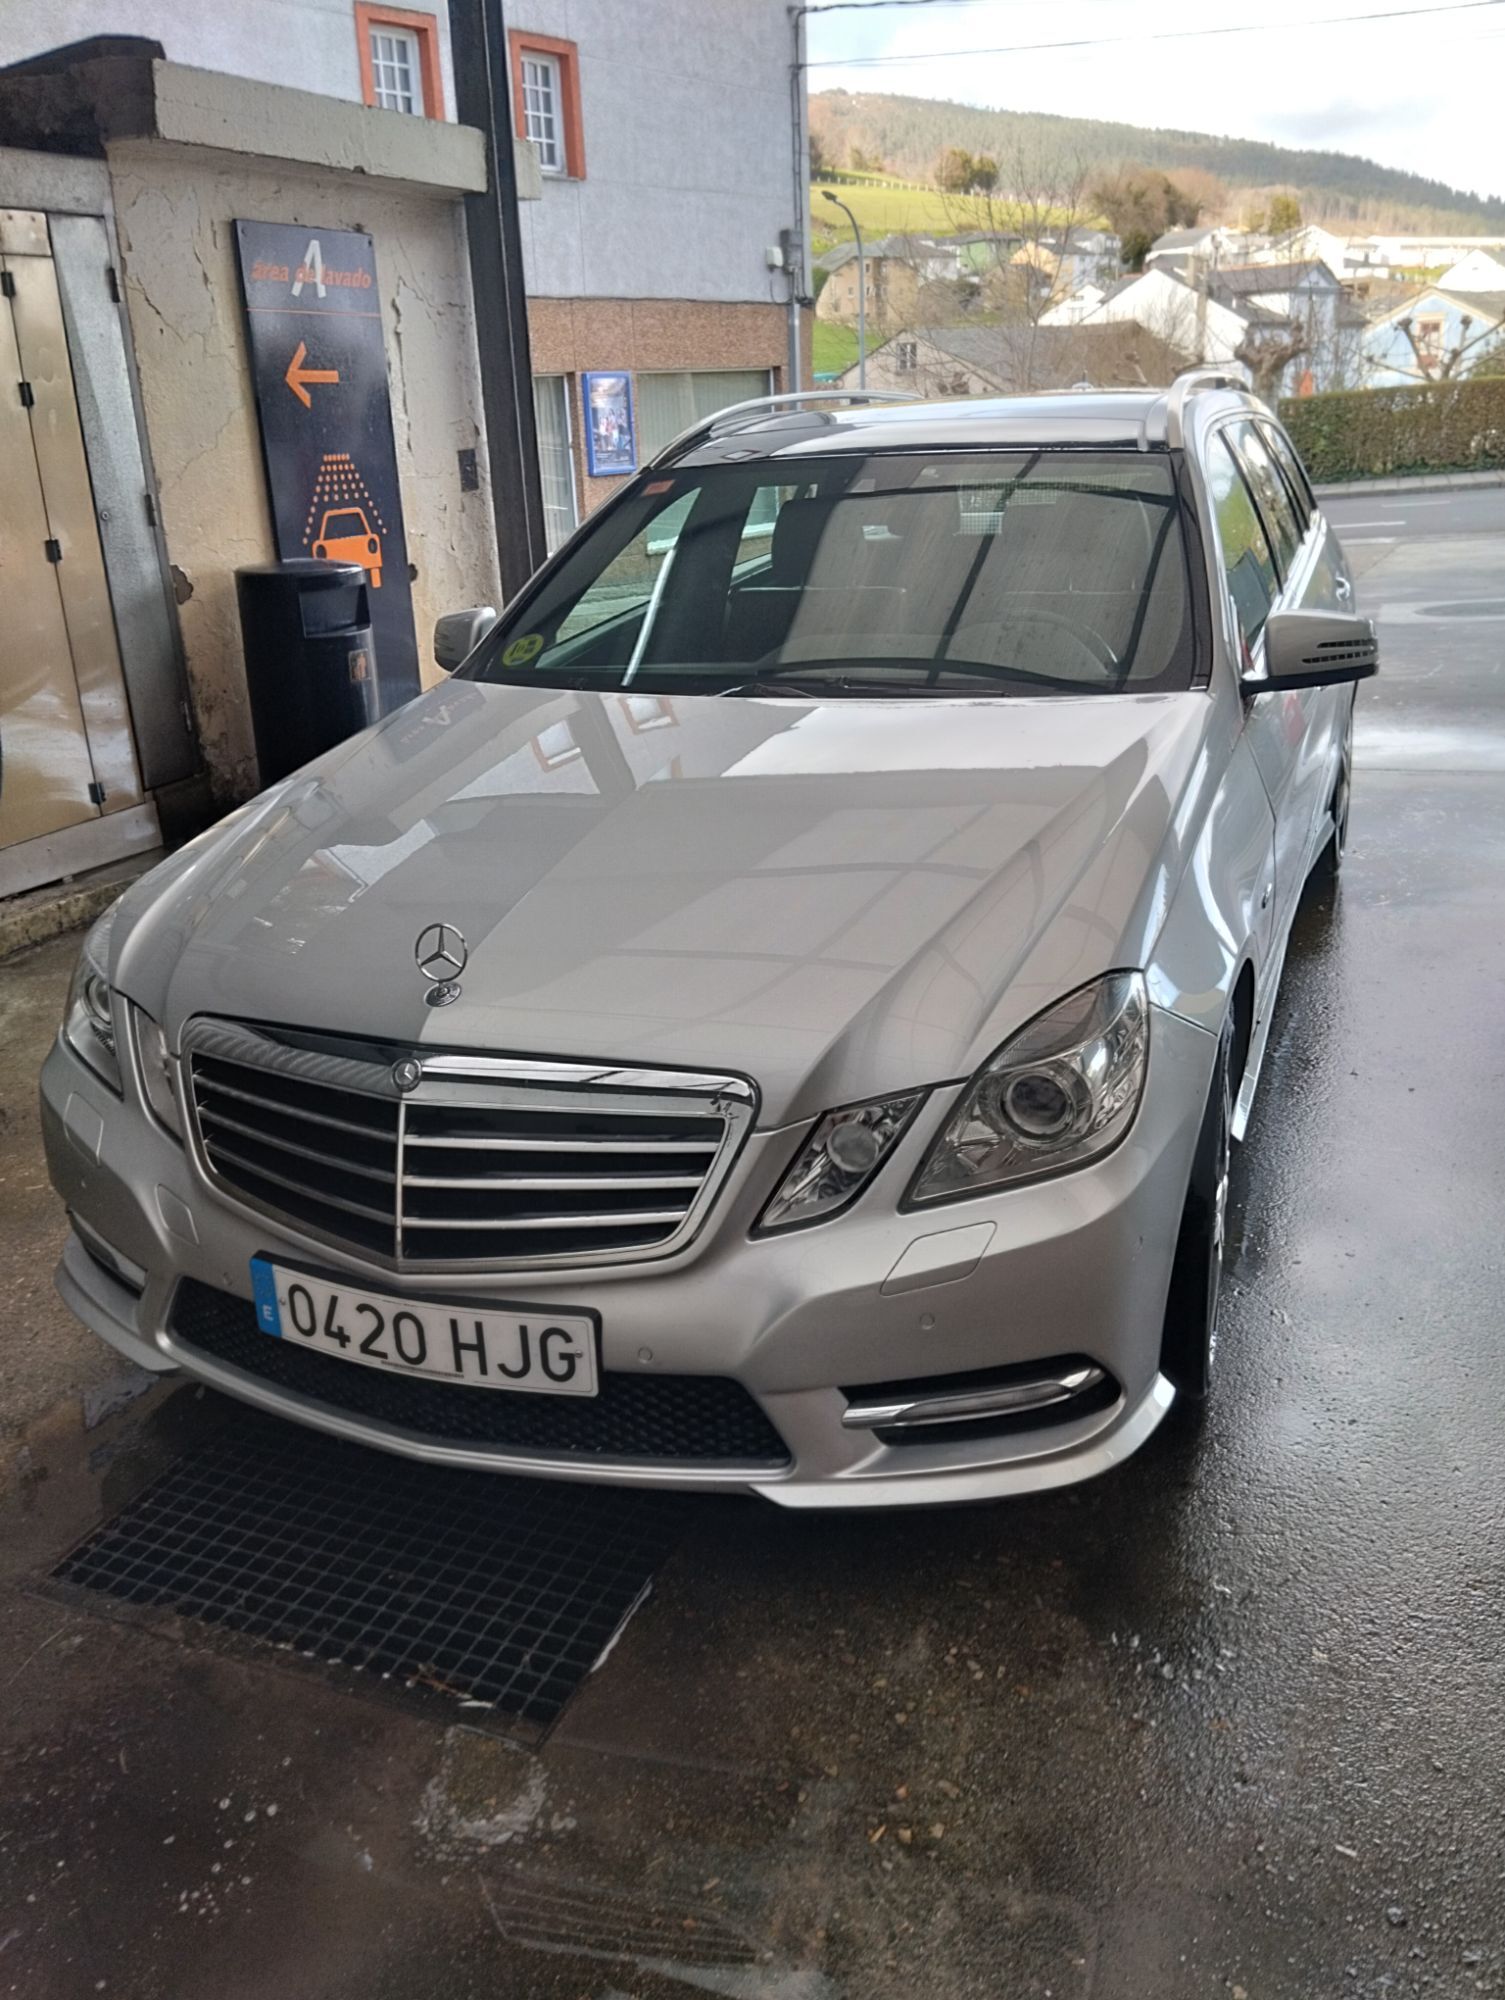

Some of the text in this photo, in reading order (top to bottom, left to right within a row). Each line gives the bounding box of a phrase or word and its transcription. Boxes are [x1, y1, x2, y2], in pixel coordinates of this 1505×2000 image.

[295, 264, 316, 284] de
[321, 264, 372, 289] lavado
[288, 1283, 577, 1382] 0420 HJG
